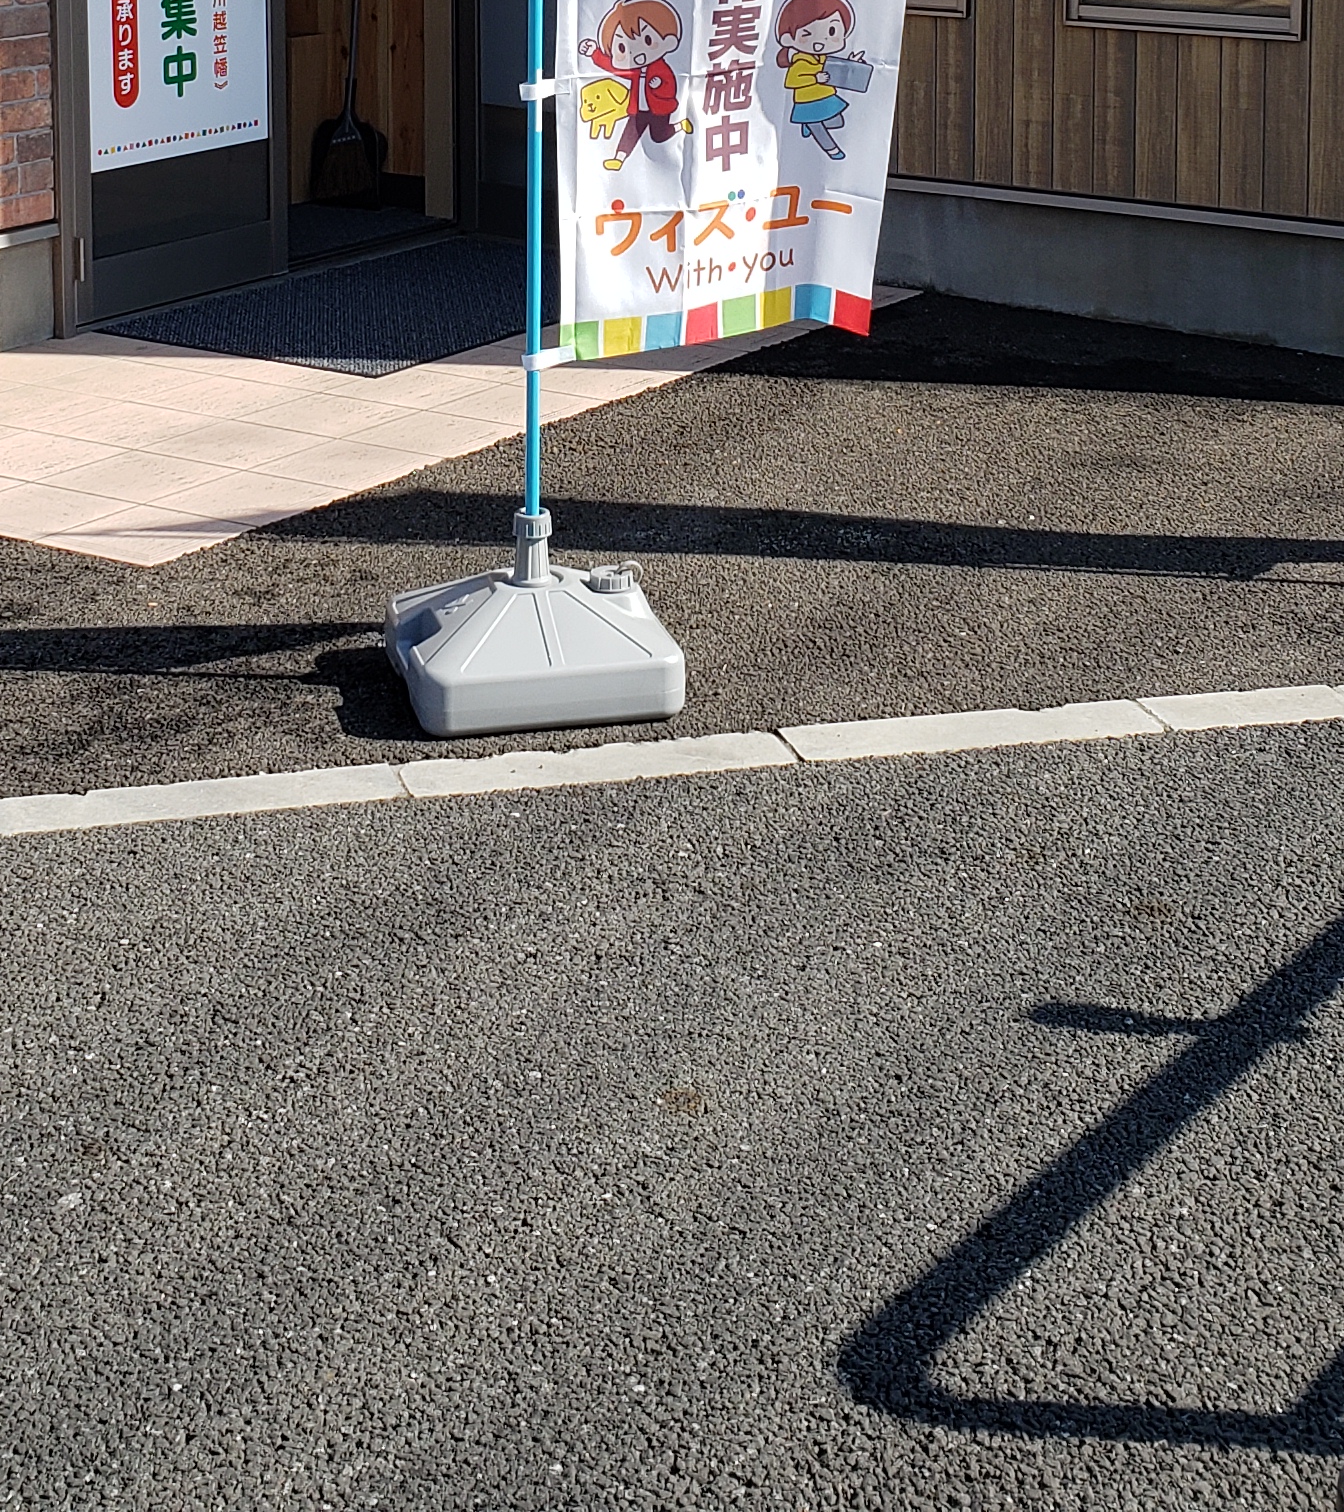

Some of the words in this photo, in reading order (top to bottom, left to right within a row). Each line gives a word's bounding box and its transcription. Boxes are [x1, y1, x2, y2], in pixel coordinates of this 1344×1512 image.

[595, 184, 853, 257] ウィズ・ユー
